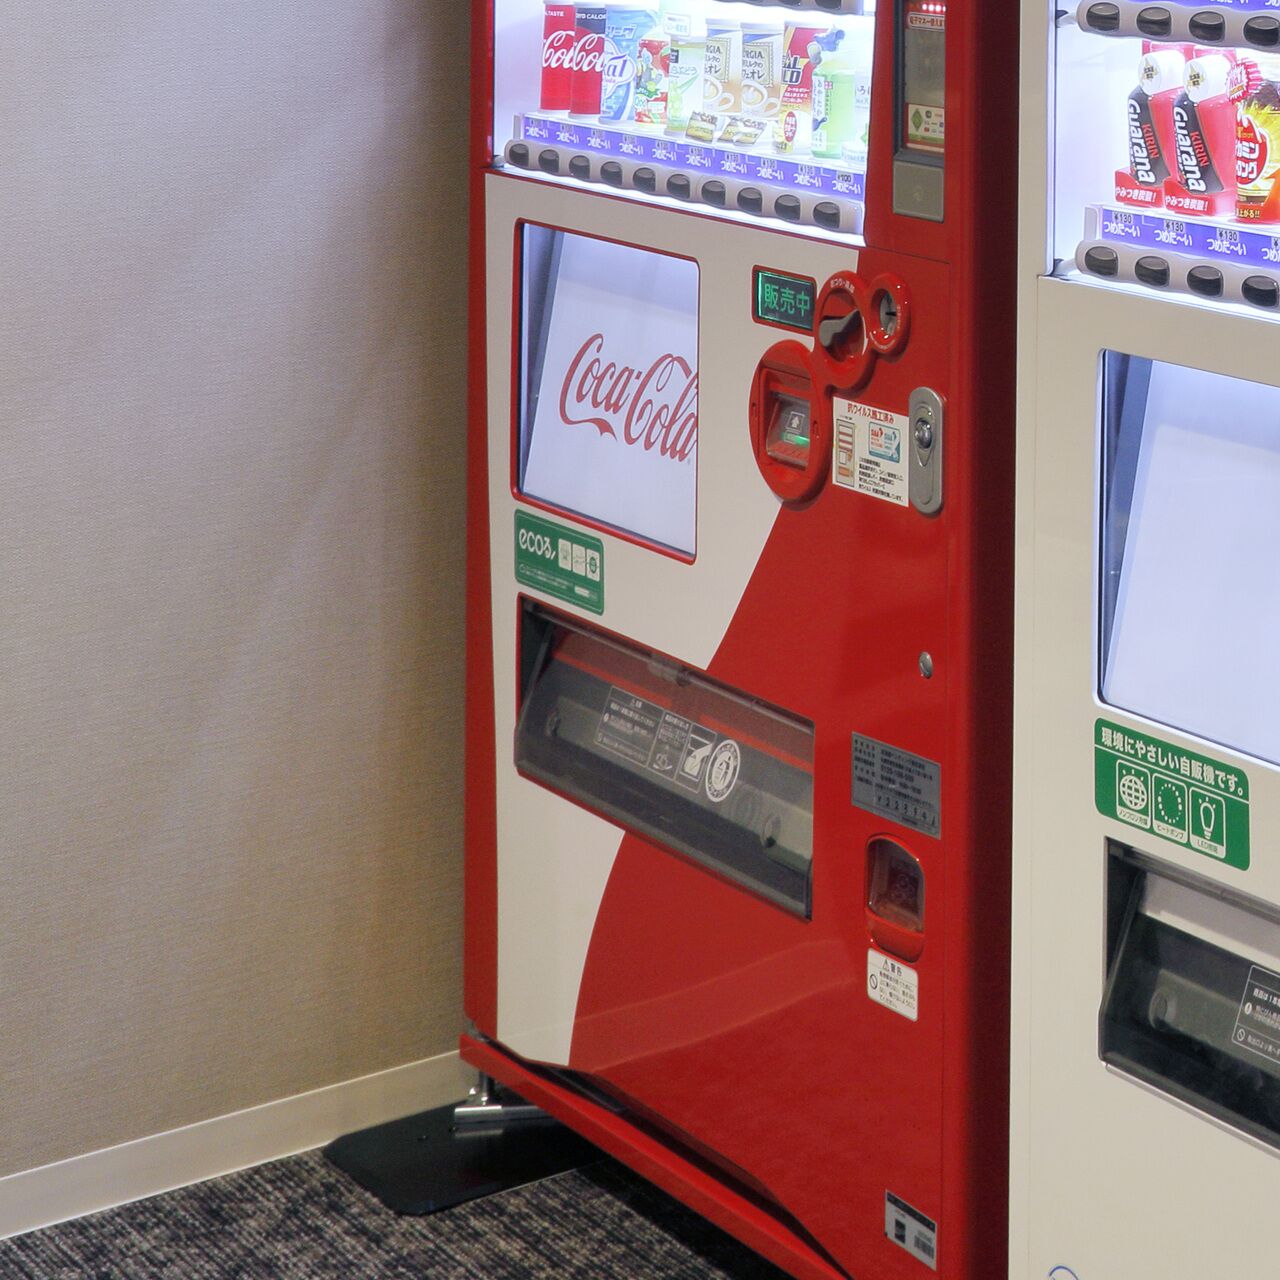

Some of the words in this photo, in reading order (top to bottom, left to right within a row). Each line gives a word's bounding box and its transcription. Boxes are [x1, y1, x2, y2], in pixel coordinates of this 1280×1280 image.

[763, 282, 811, 318] 販売中
[1101, 727, 1243, 796] 環境にやさしい自販機です。
